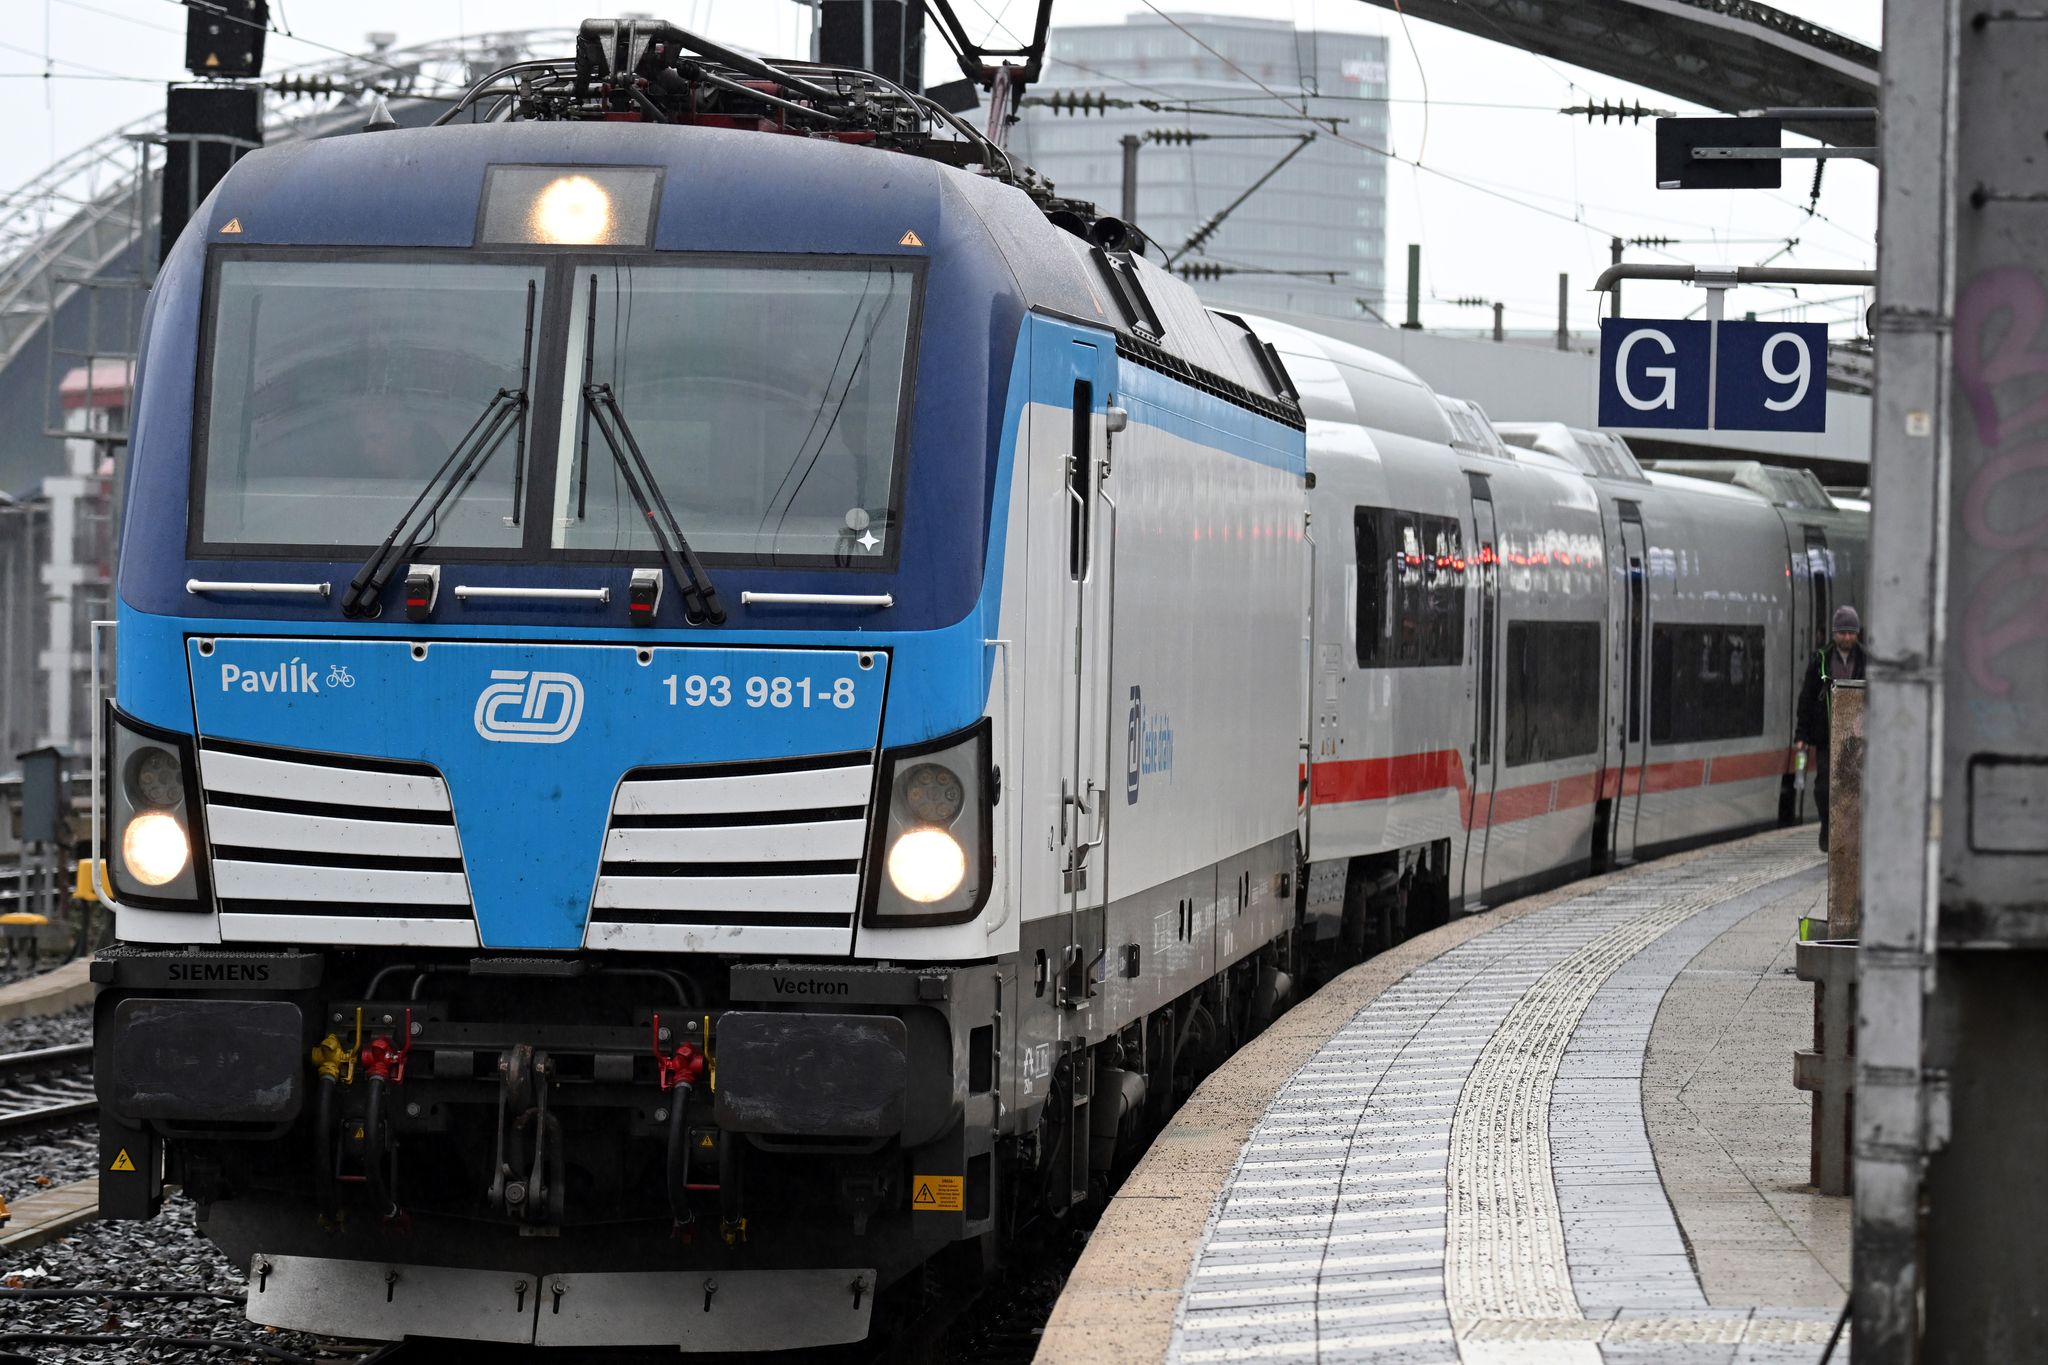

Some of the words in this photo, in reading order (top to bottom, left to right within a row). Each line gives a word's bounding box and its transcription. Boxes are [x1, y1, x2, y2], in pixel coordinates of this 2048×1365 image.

[1616, 328, 1676, 411] G
[1762, 332, 1811, 412] 9
[662, 674, 732, 707] 193
[745, 676, 855, 709] 981-8
[168, 963, 270, 981] SIEMENS
[772, 977, 849, 995] Vectron
